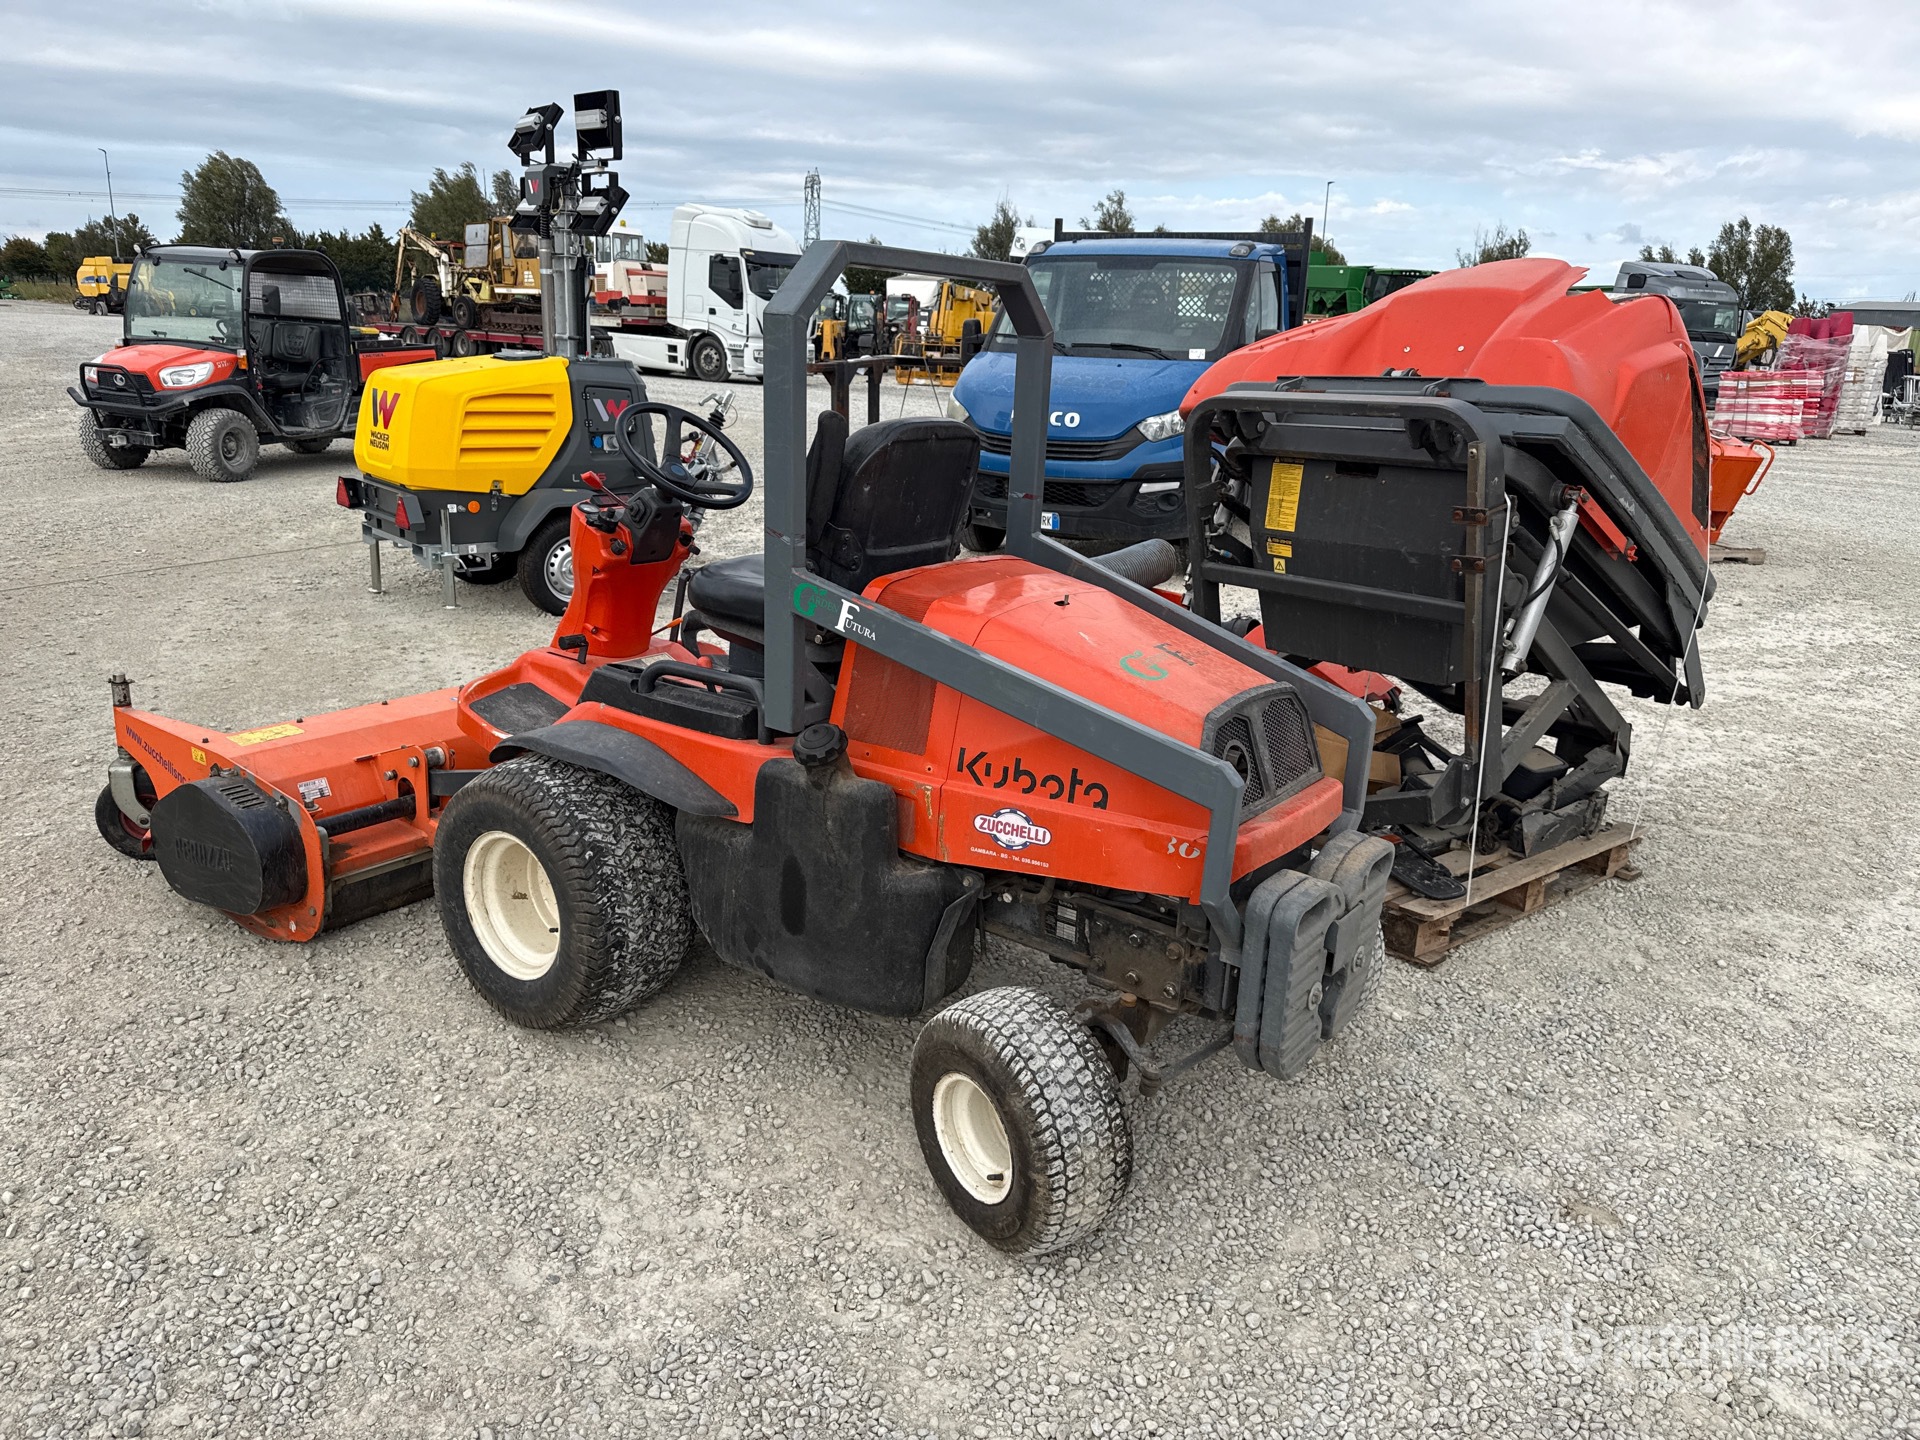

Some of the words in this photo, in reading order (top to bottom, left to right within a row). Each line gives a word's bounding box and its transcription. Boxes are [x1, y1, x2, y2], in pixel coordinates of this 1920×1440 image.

[369, 438, 390, 451] NEUSON
[370, 430, 390, 443] WACKER
[834, 598, 876, 641] FUTURA
[956, 747, 1109, 810] Kubota
[978, 816, 1048, 844] ZUCCHELLI
[970, 846, 997, 857] GAMBARA
